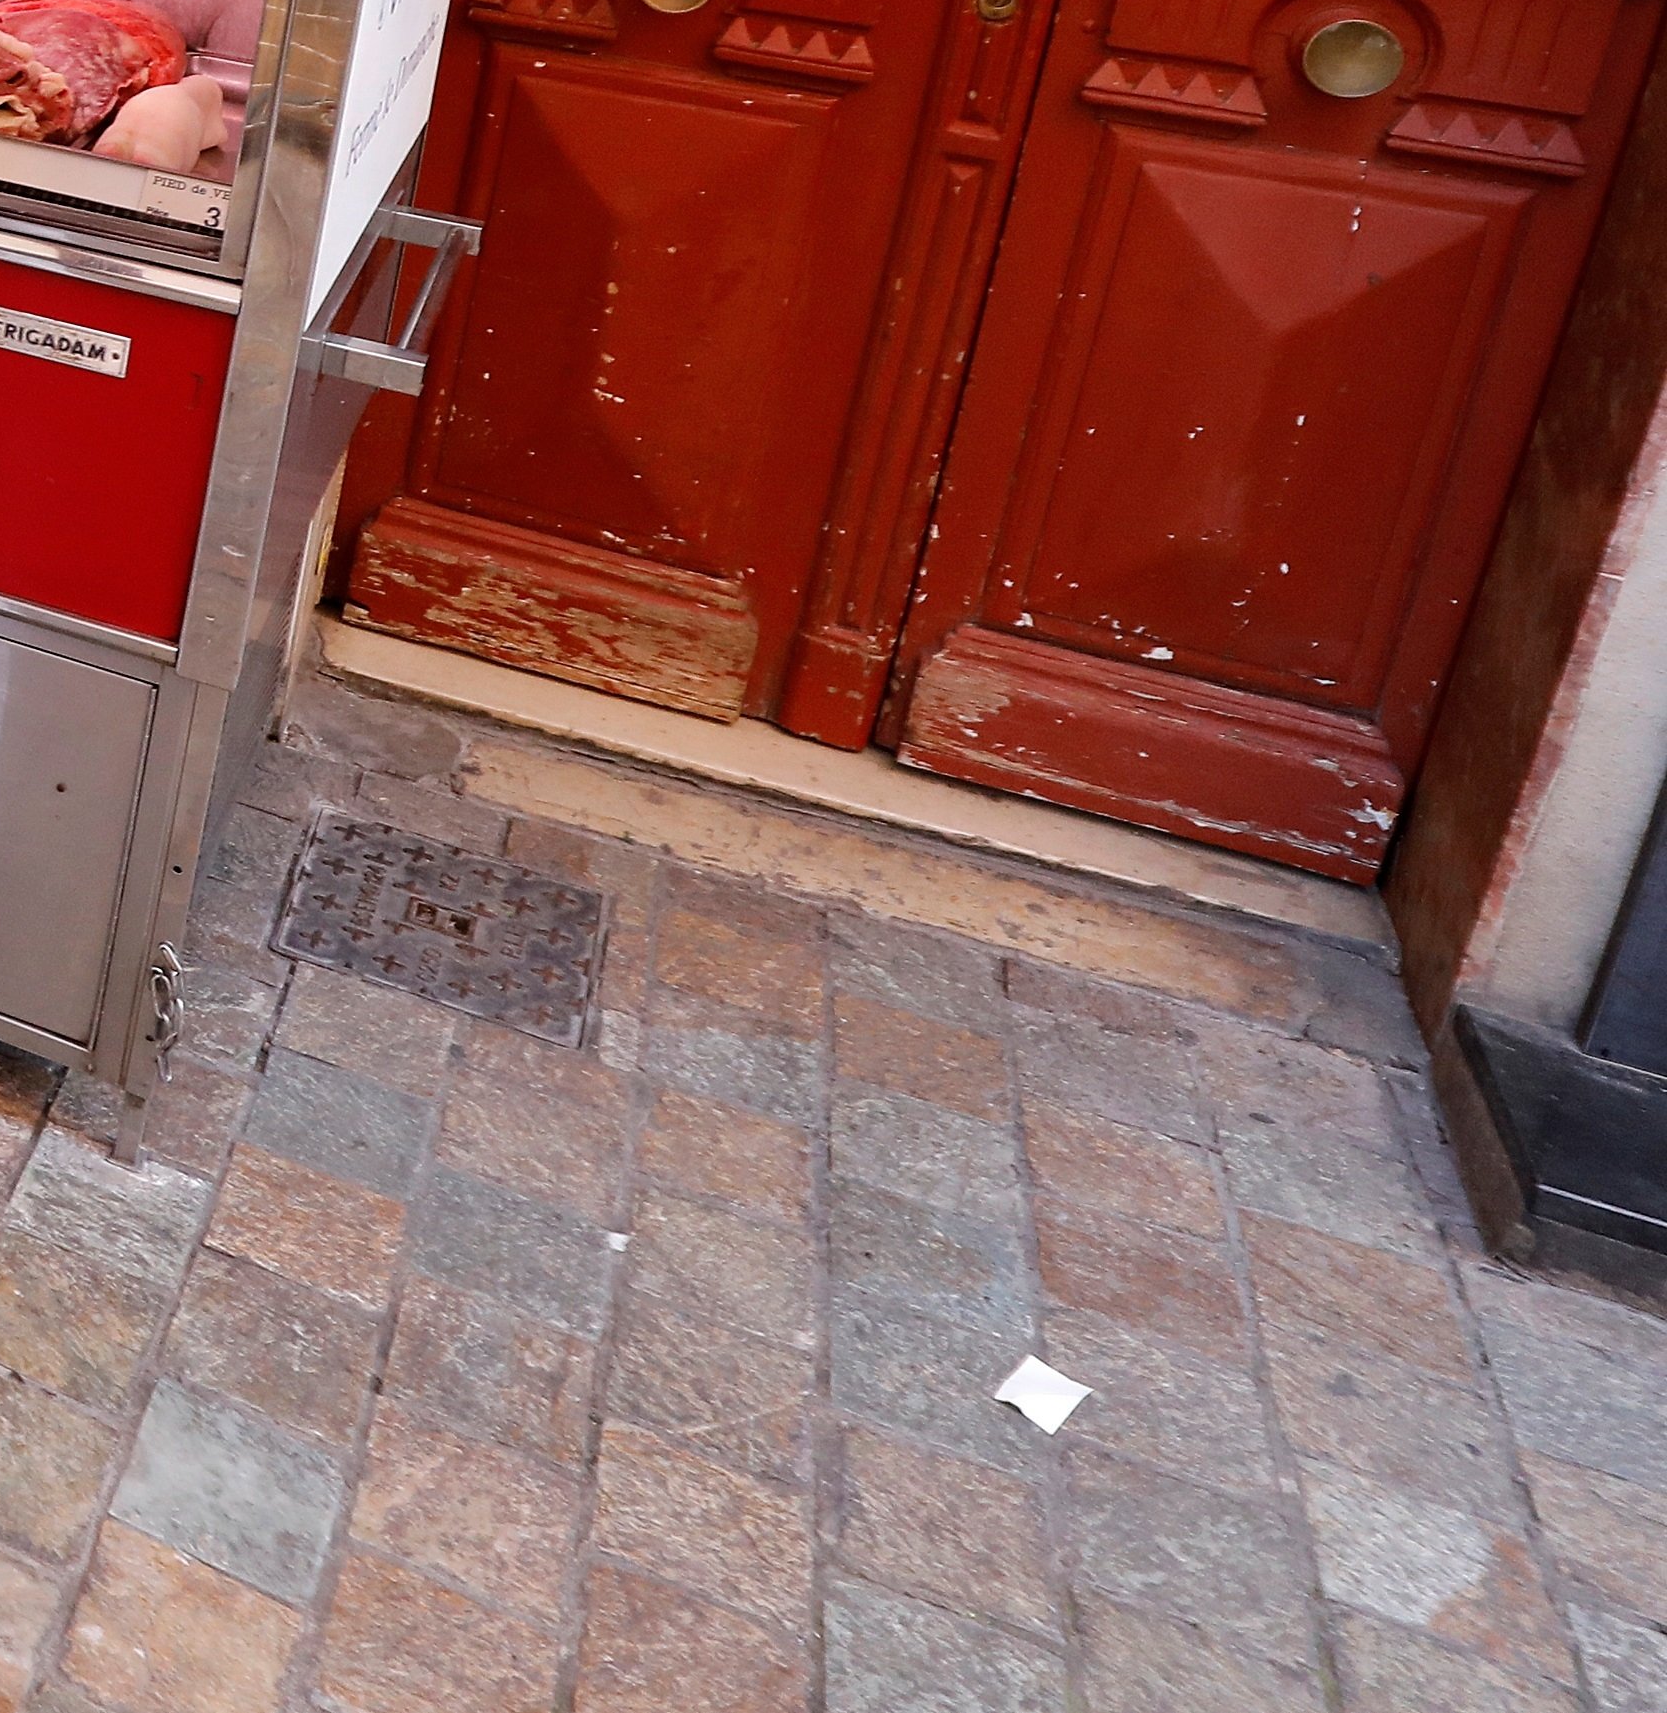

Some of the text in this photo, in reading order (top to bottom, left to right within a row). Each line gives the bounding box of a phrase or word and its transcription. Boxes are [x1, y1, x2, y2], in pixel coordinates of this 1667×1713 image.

[152, 175, 187, 191] PIED
[191, 185, 207, 195] de
[204, 206, 221, 228] 3
